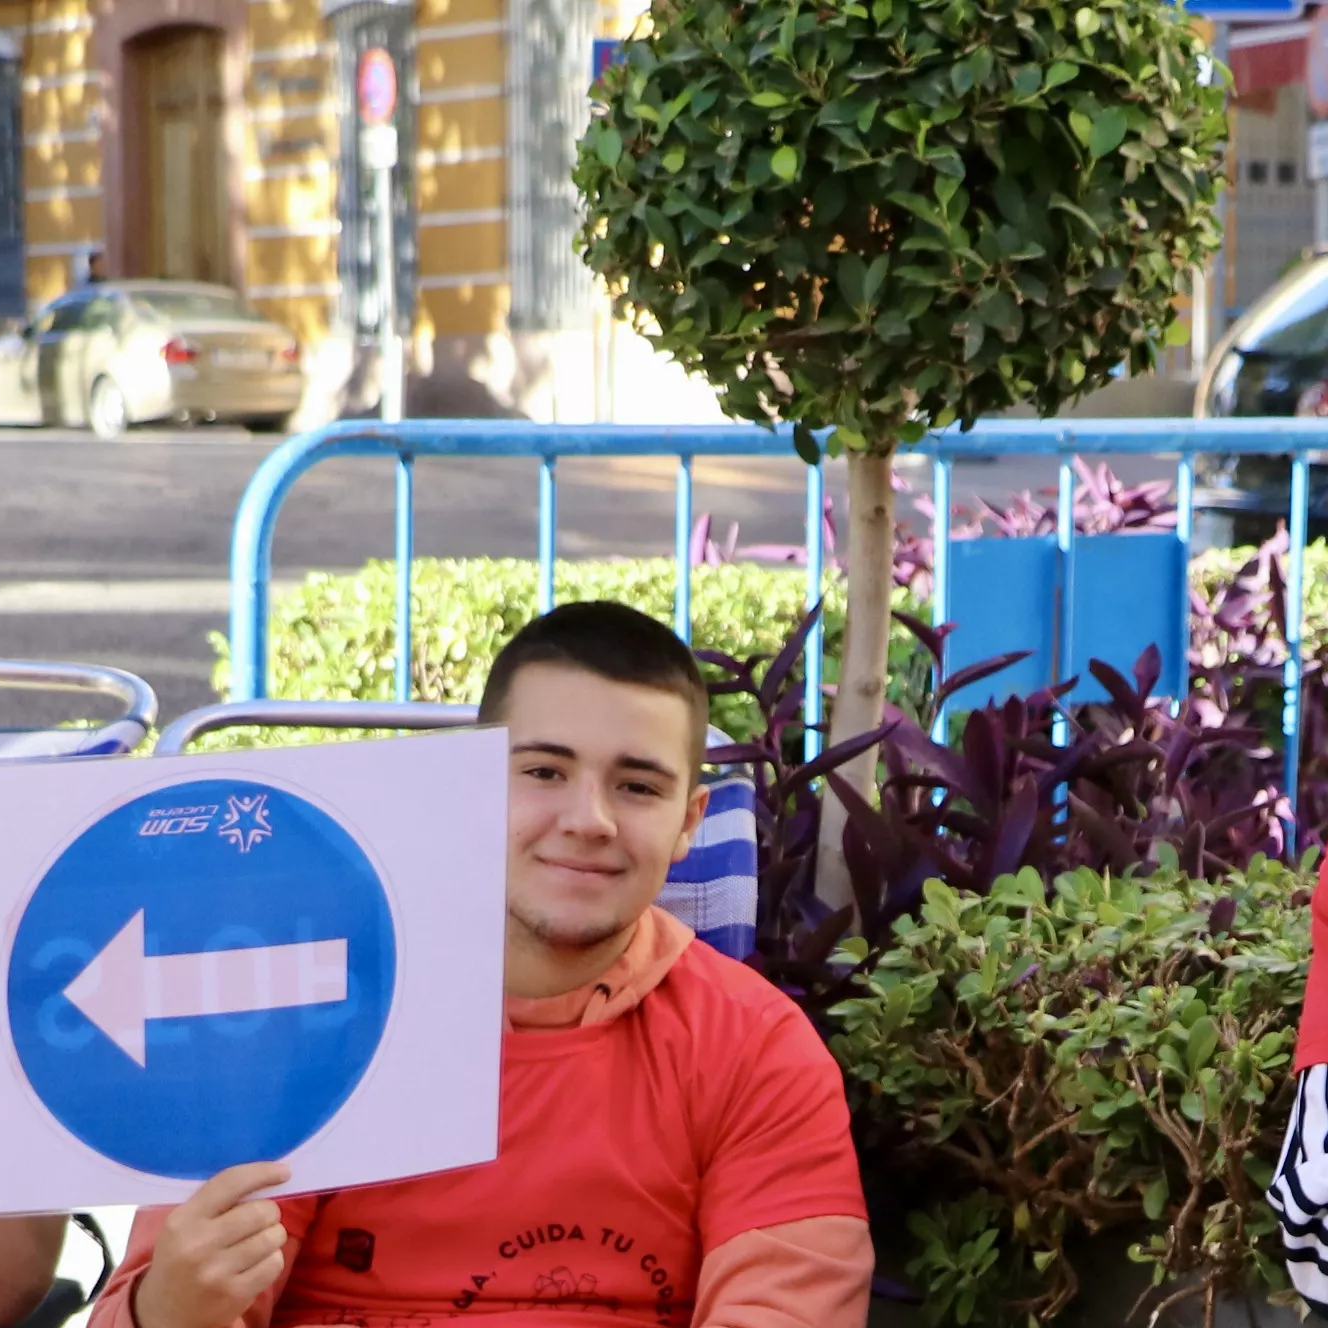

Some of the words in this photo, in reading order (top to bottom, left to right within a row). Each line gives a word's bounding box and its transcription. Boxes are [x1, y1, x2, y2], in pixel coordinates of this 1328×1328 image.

[148, 804, 220, 817] Lucena
[498, 1224, 586, 1259] CUIDA
[600, 1228, 635, 1253] TU
